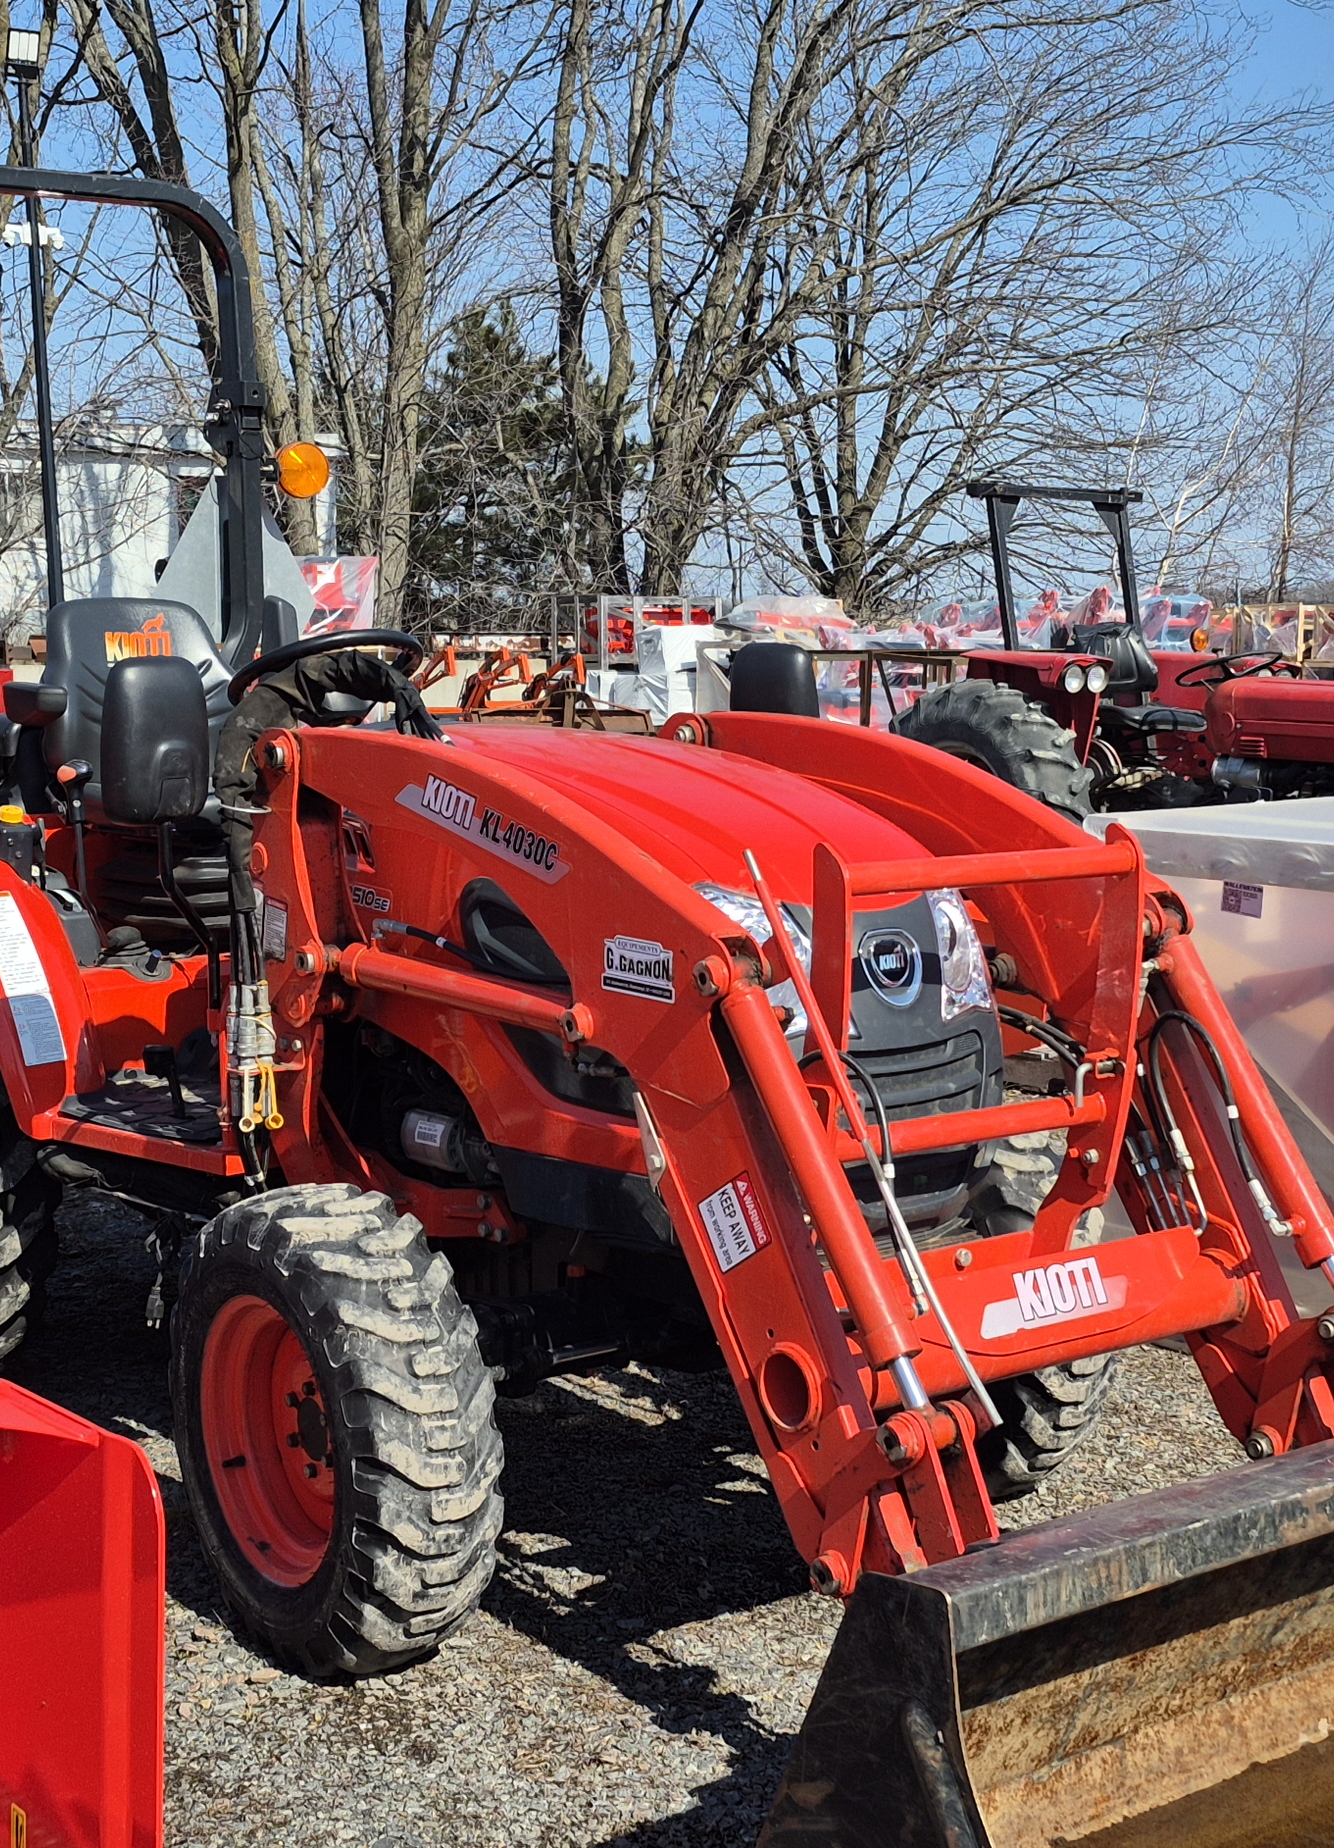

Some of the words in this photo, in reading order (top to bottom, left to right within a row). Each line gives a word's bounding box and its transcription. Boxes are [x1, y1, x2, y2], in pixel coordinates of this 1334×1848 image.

[104, 631, 172, 662] KIOTI
[421, 773, 477, 830] KIOTI
[479, 806, 560, 872] KL4030C
[350, 885, 390, 911] 510SE
[879, 952, 905, 971] KIOTI
[705, 1199, 716, 1219] from
[711, 1217, 727, 1249] working
[722, 1249, 733, 1266] area
[717, 1188, 737, 1219] KEEP
[728, 1221, 750, 1255] AWAY
[743, 1193, 767, 1245] WARNING
[1012, 1256, 1108, 1322] KIOTI
